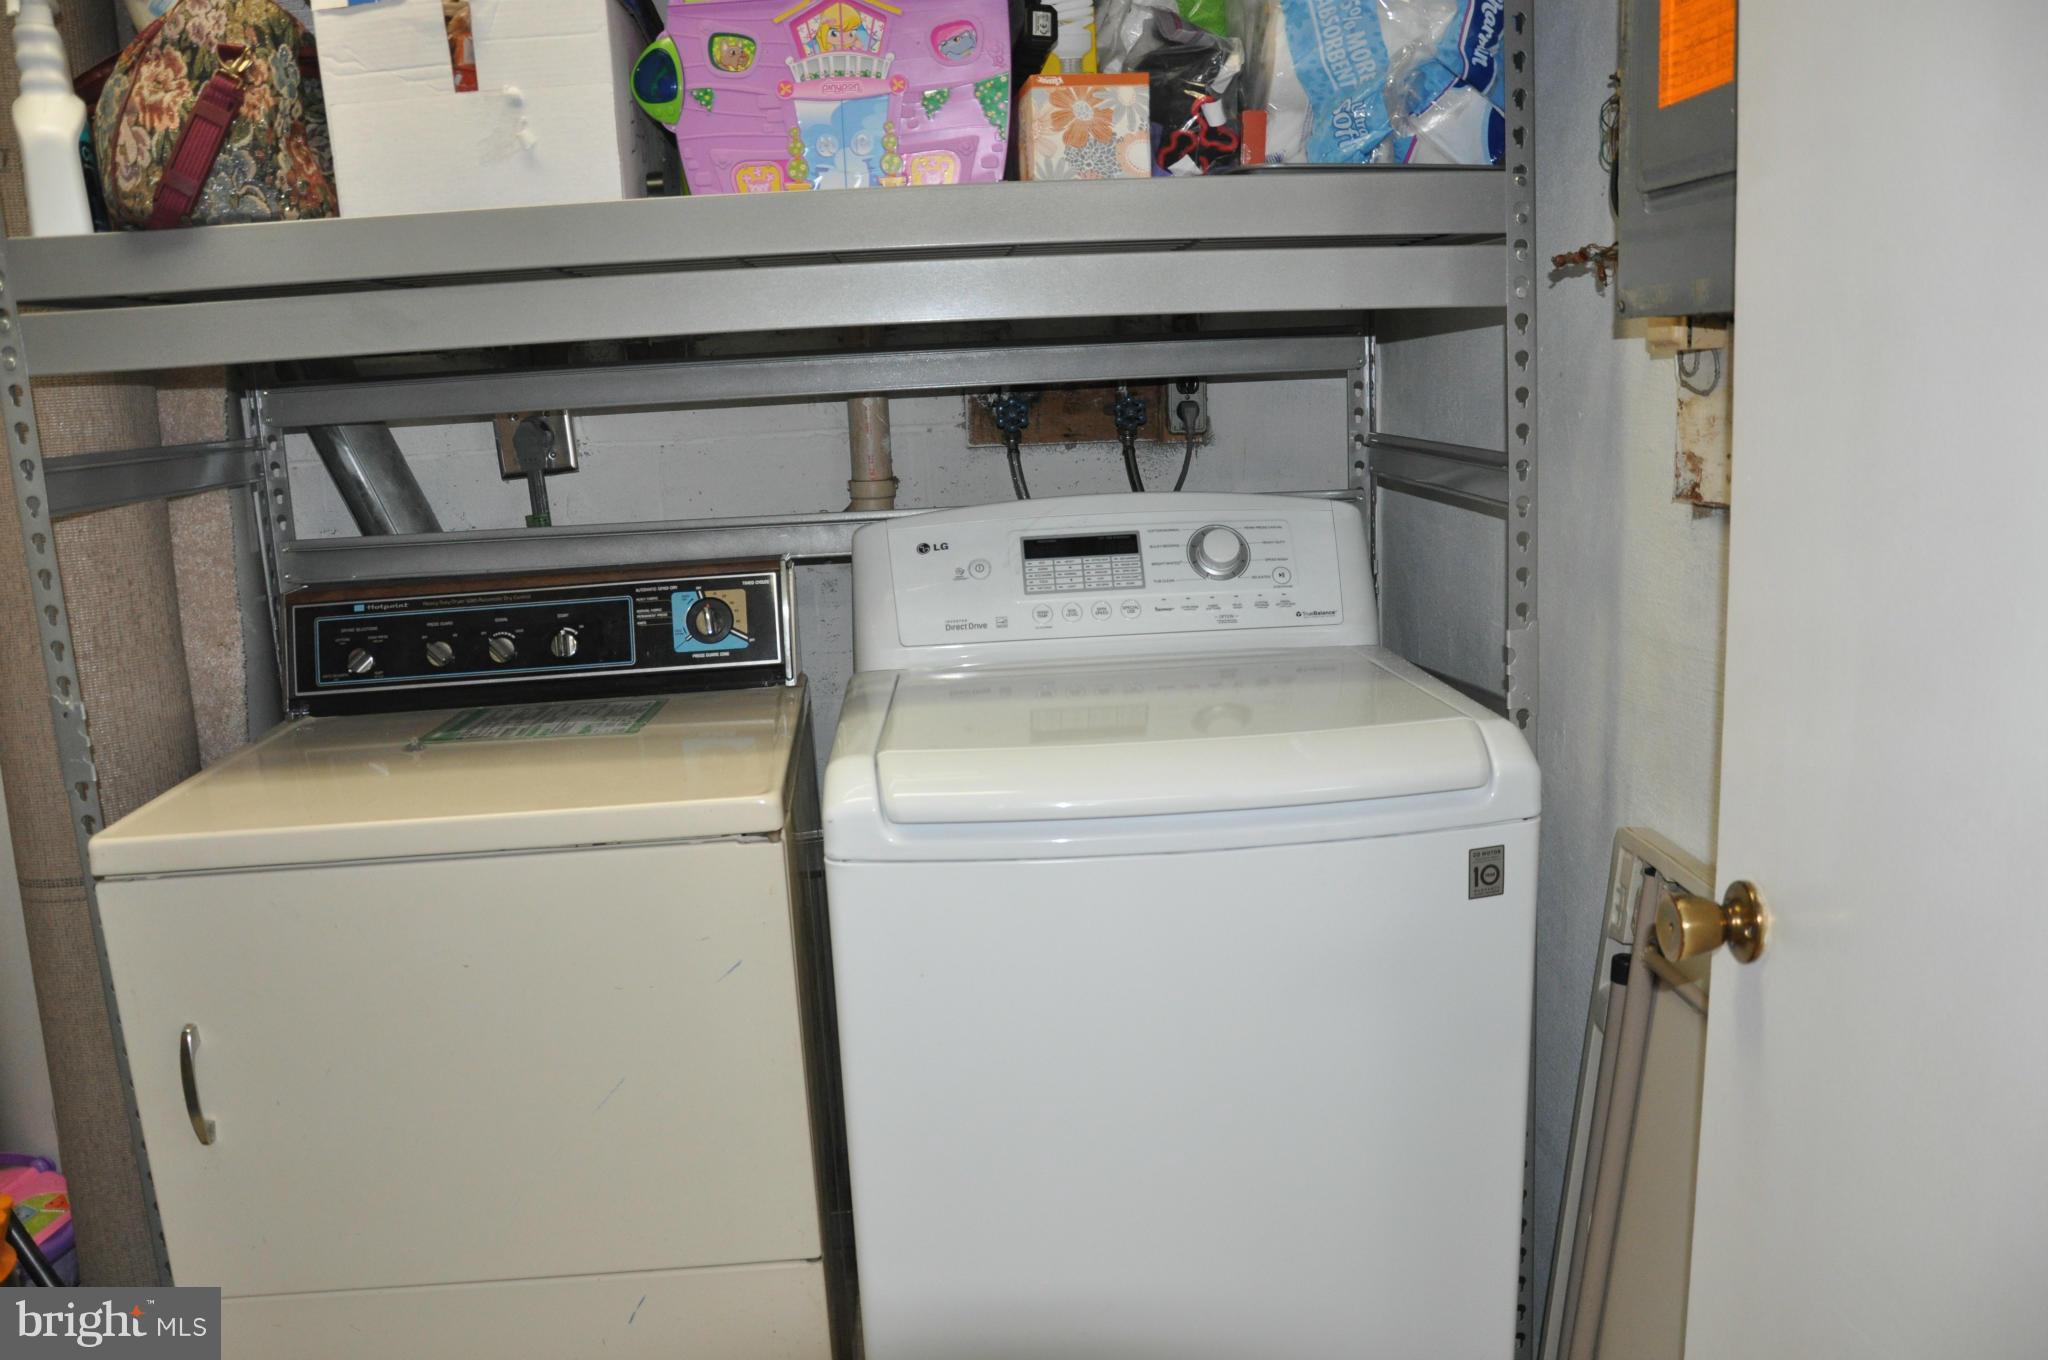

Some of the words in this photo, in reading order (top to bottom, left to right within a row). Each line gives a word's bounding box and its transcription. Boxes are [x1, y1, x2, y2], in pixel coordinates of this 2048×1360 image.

[1473, 0, 1504, 67] harmin
[1344, 30, 1378, 86] MORE
[933, 542, 949, 552] LG
[367, 602, 408, 611] Hotpoint
[945, 623, 967, 631] Direct
[968, 622, 988, 630] Drive
[1473, 864, 1500, 887] 10
